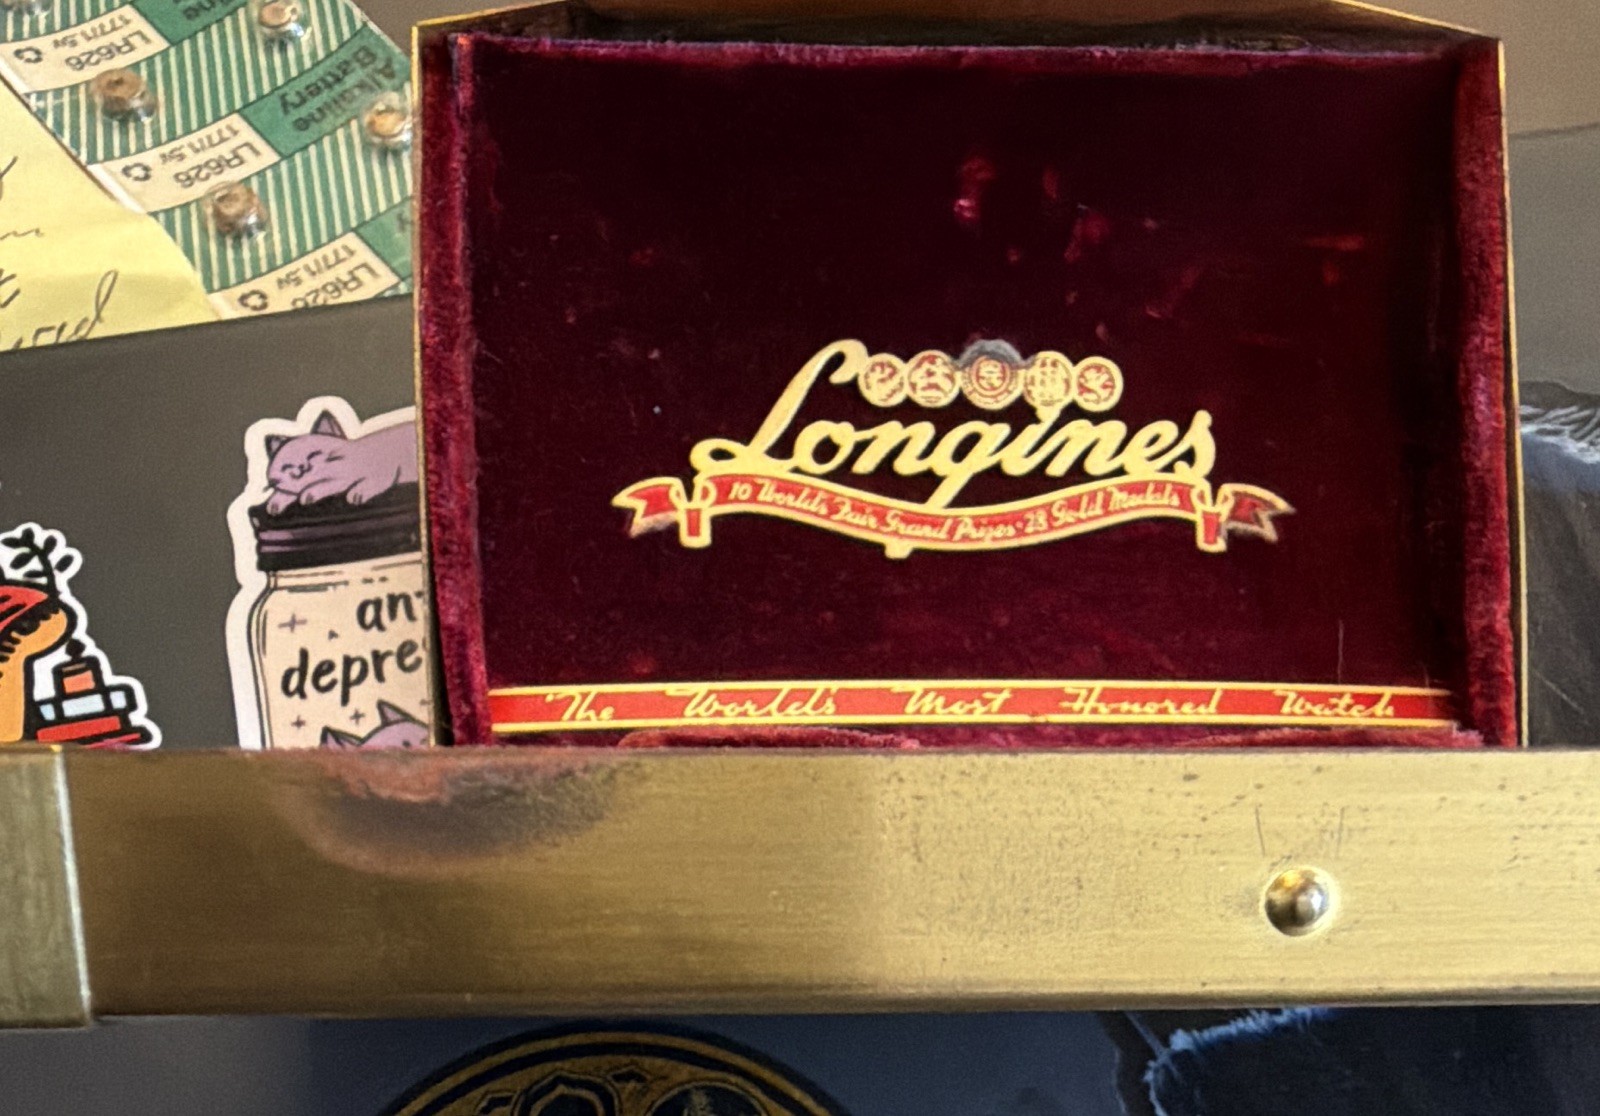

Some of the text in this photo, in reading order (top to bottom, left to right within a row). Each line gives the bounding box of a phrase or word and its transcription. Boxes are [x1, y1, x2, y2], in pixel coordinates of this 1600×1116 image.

[65, 30, 152, 71] LR626
[279, 45, 377, 115] Battery
[173, 142, 262, 188] LR626
[690, 338, 1217, 510] Longines
[728, 482, 751, 500] 10
[831, 496, 878, 528] Fair
[880, 509, 949, 539] Grand
[1051, 491, 1104, 526] Gold
[356, 591, 425, 632] an
[281, 637, 426, 707] depre
[546, 690, 614, 721] The
[890, 686, 1012, 715] Most
[1059, 686, 1222, 715] Honored
[1273, 690, 1394, 717] Watch
